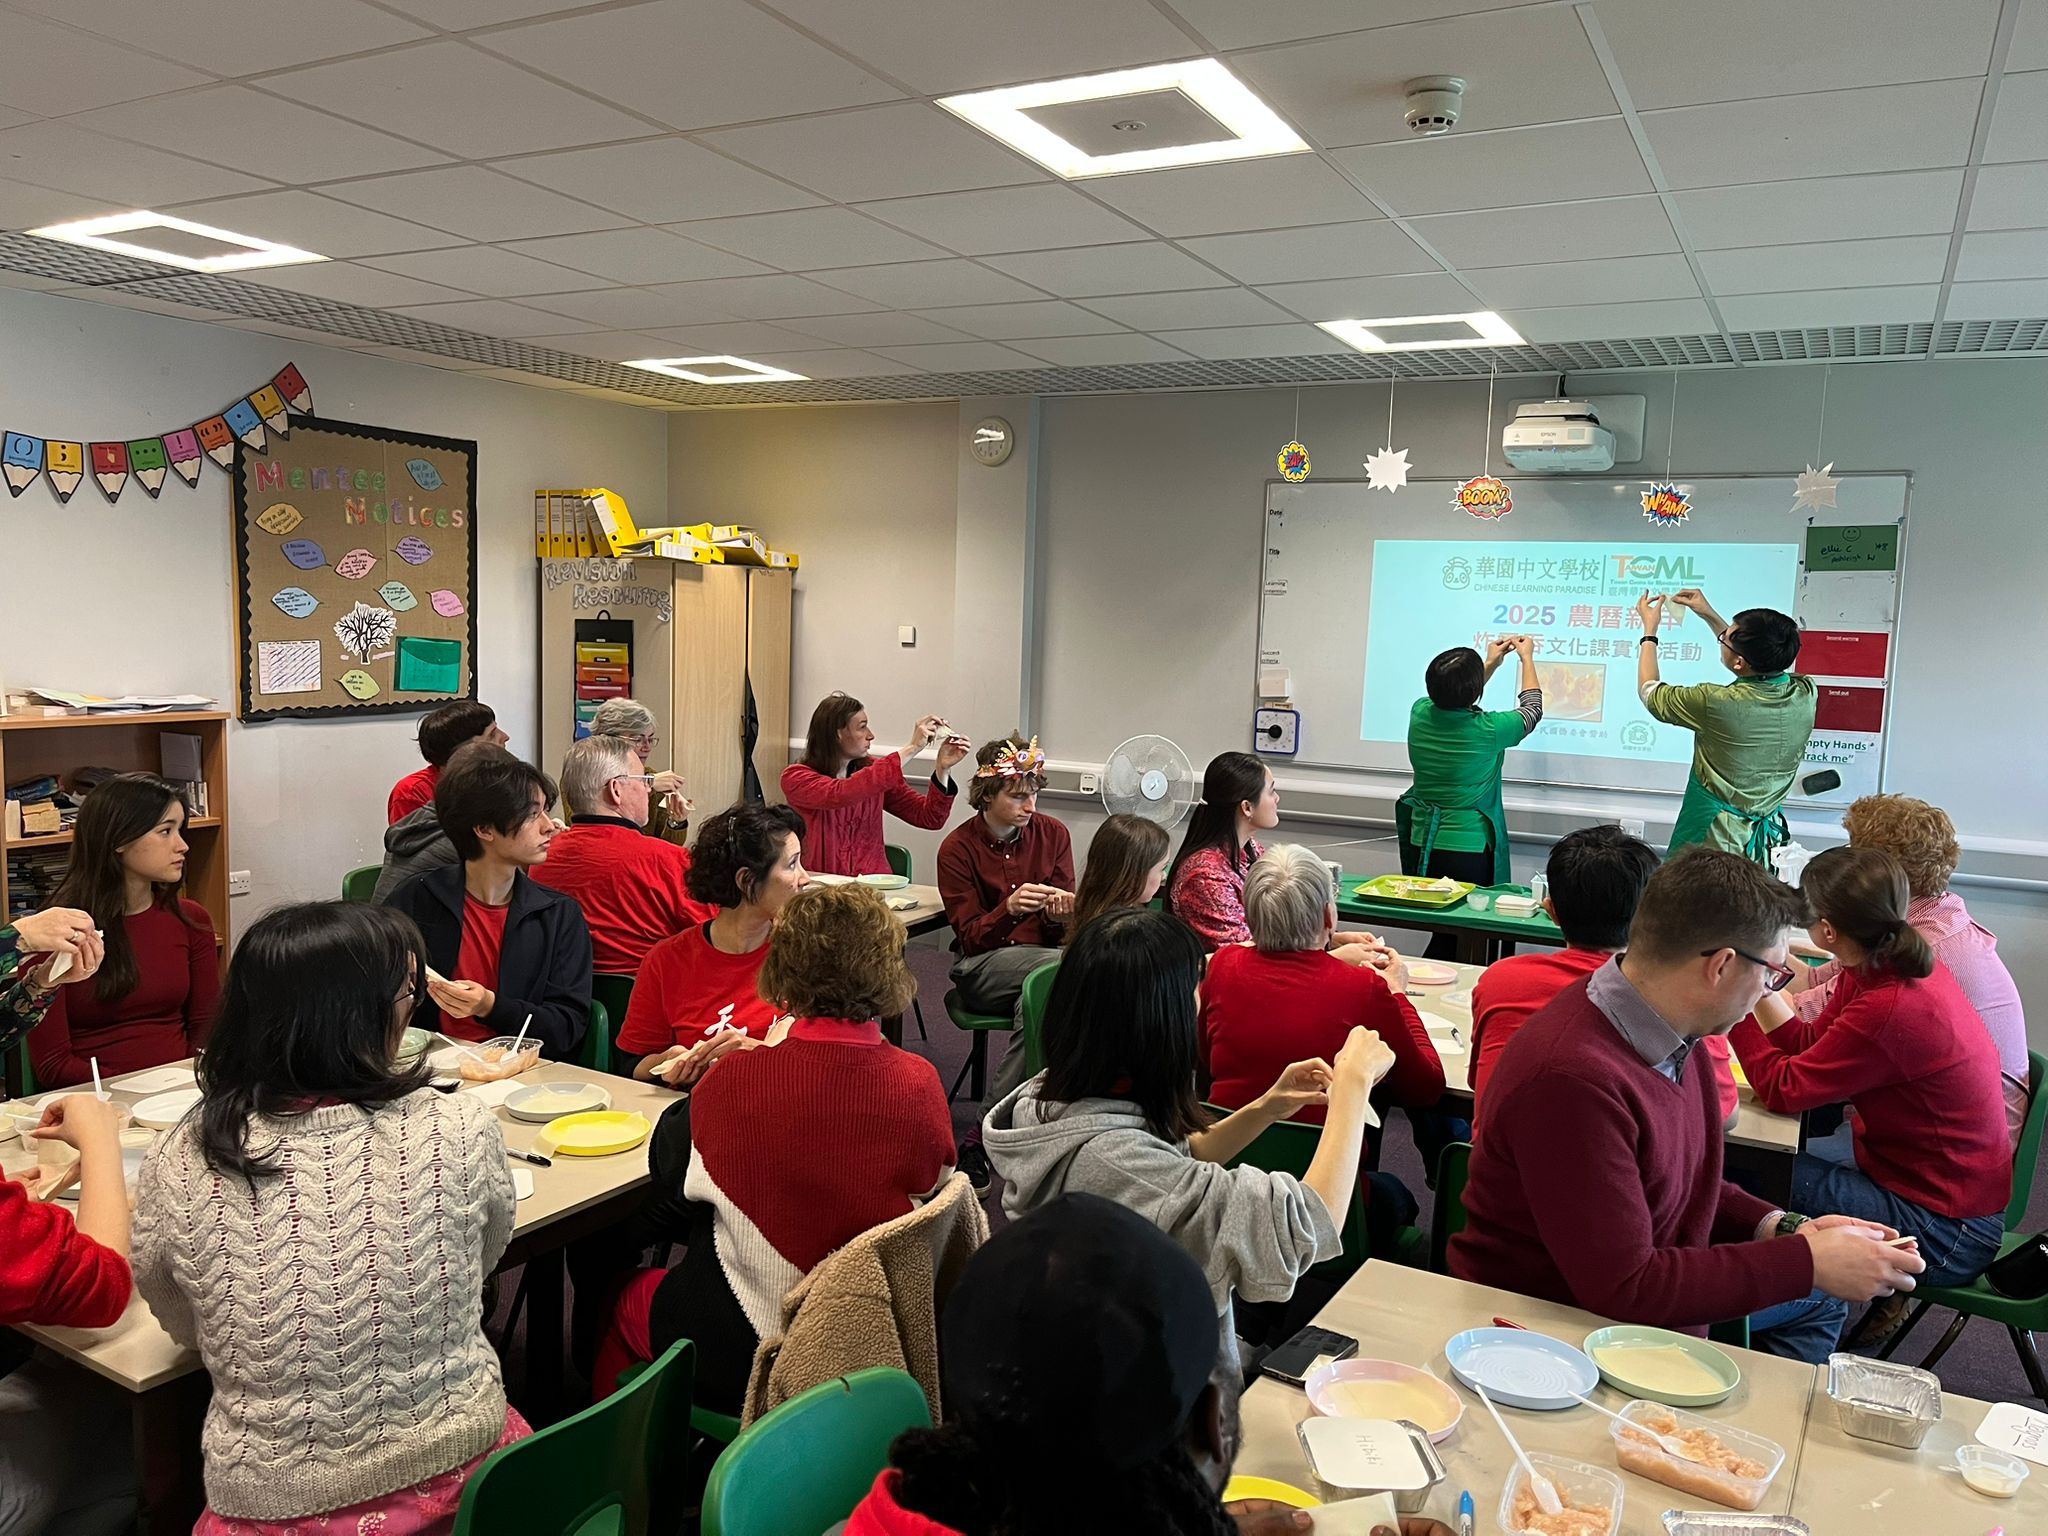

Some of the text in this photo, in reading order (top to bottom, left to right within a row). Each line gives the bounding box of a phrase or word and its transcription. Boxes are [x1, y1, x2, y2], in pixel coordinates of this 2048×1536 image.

[254, 459, 386, 493] Mentee
[1462, 488, 1507, 507] BOOM!
[1643, 491, 1687, 517] WHAM!
[344, 495, 465, 529] Notices
[544, 558, 637, 591] Revision
[1474, 556, 1601, 582] 華園中文學校
[1611, 555, 1705, 580] TCML
[1474, 584, 1597, 595] CHINESE LEARNING PARADISE
[573, 583, 673, 623] Resources
[1493, 603, 1557, 626] 2025
[1833, 740, 1867, 751] Hands
